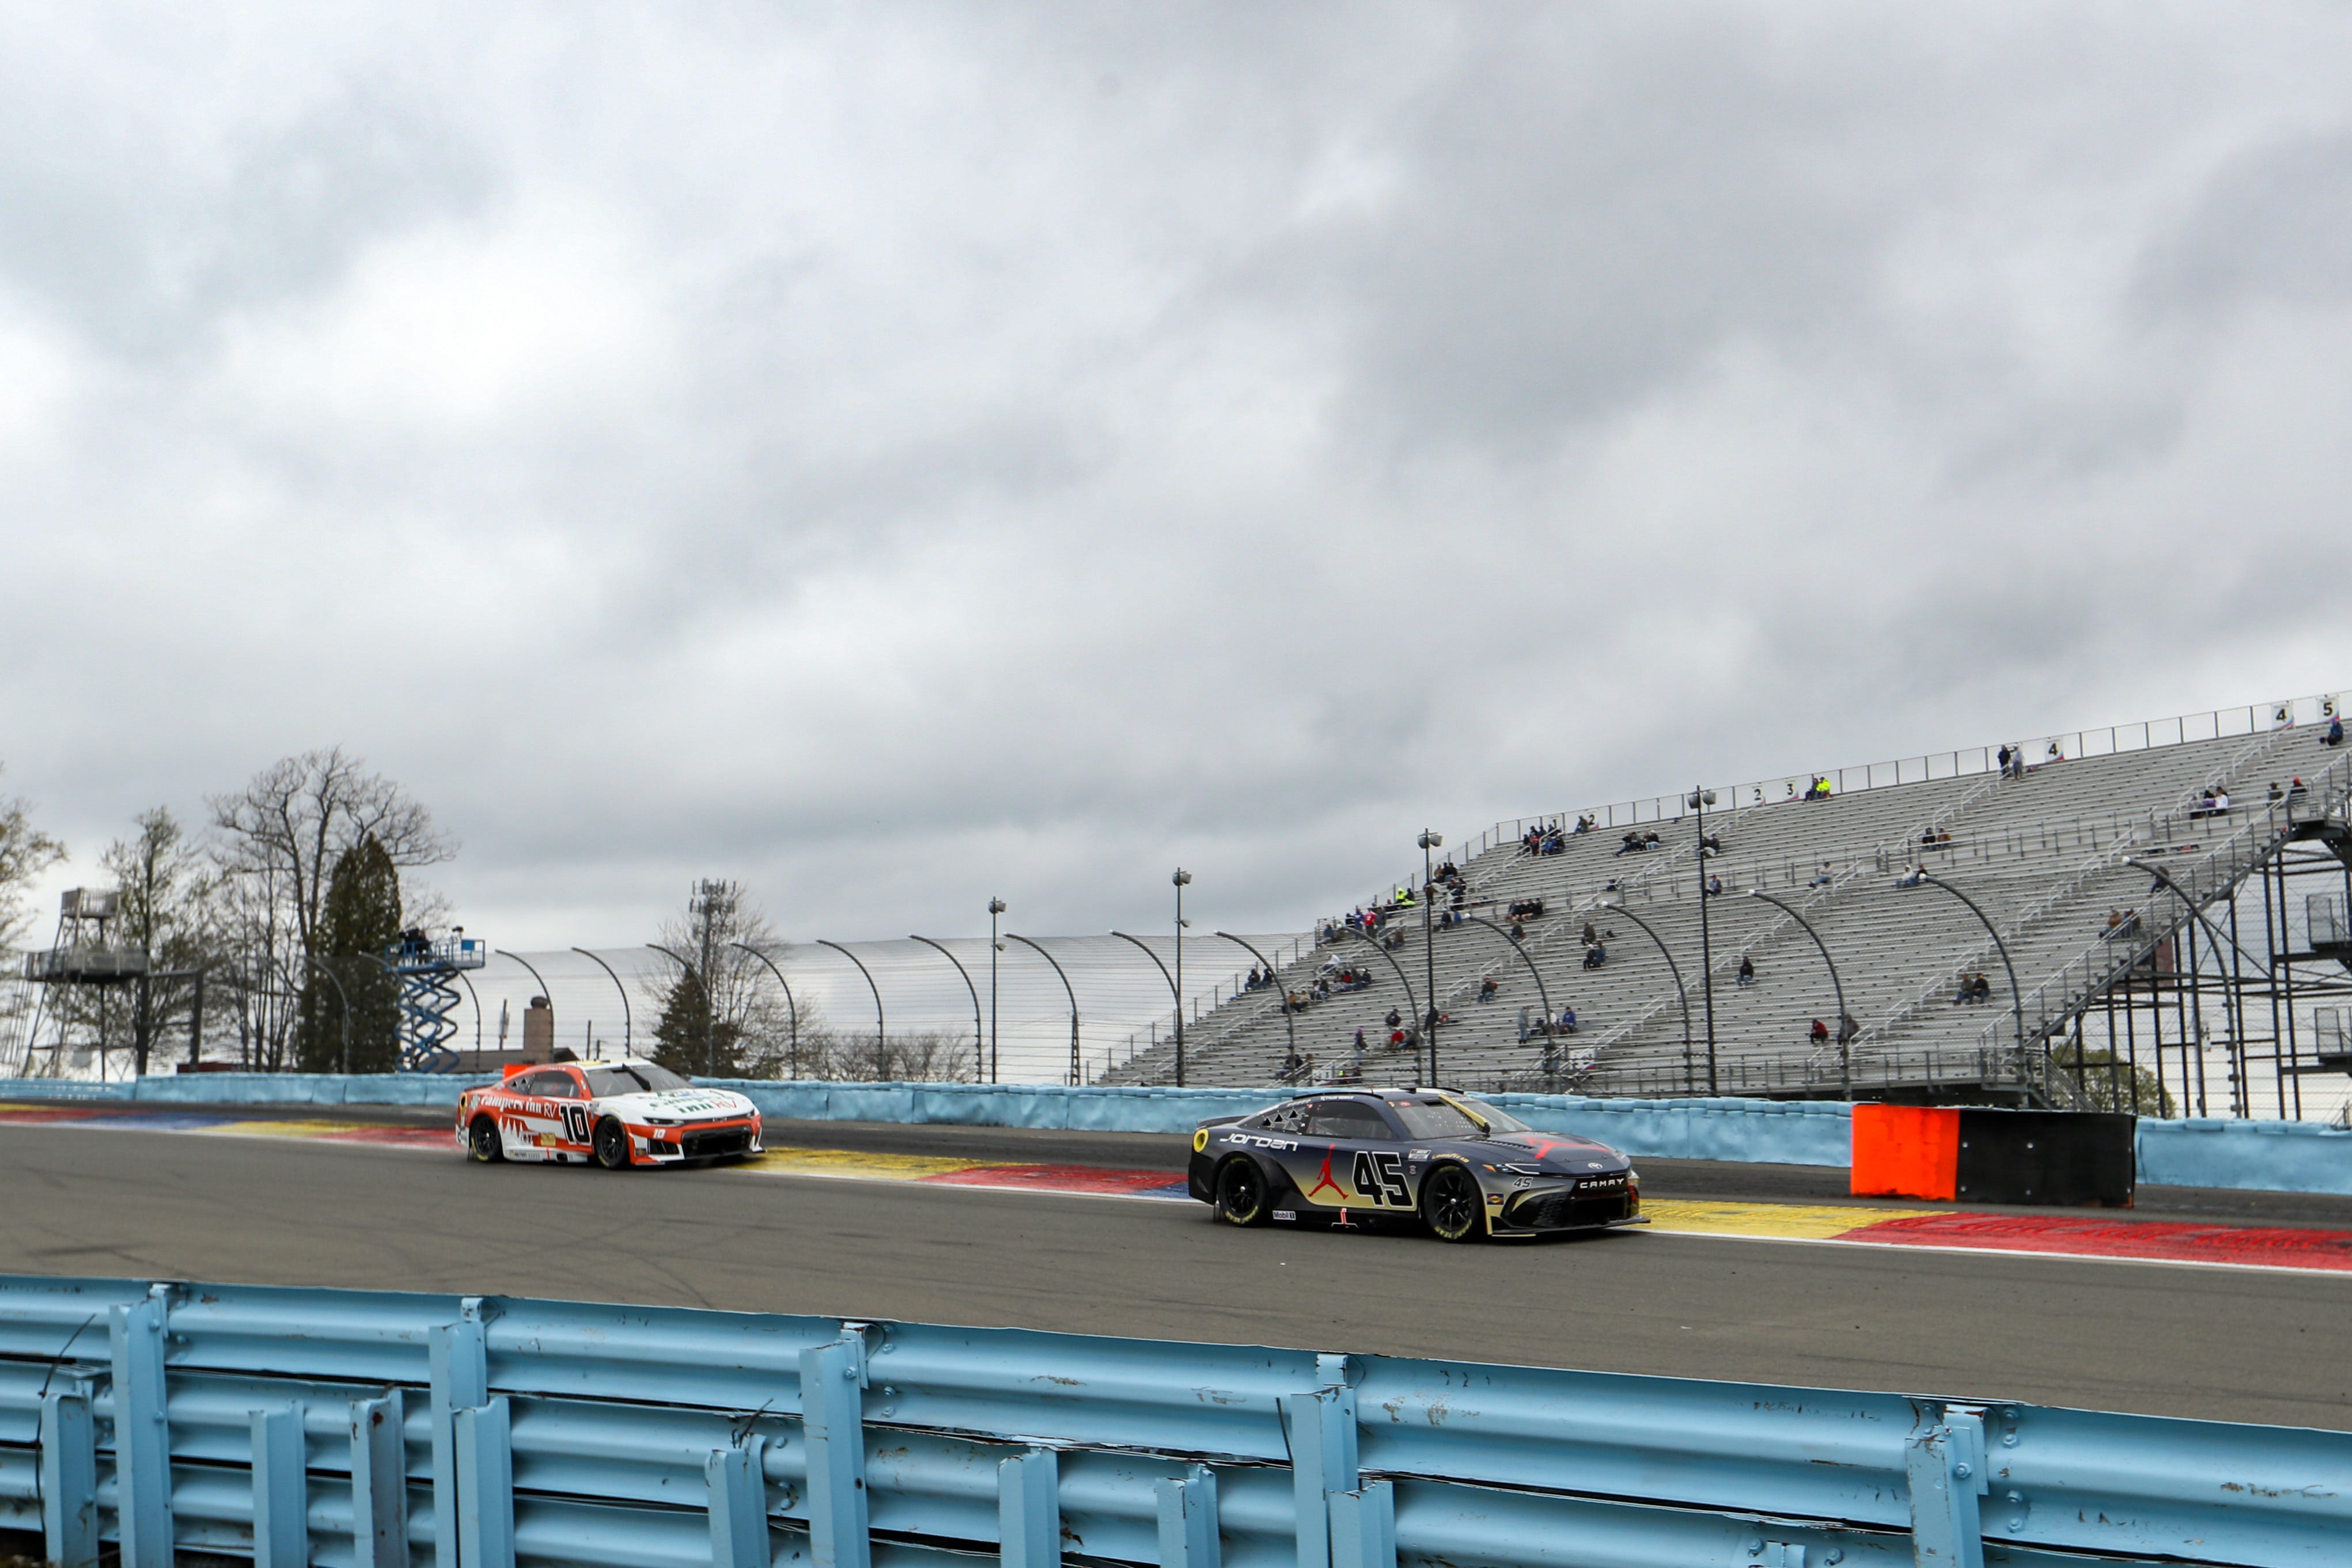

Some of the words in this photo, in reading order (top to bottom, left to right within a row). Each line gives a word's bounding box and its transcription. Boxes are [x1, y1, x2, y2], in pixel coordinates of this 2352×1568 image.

[2276, 708, 2286, 722] 4
[2323, 702, 2333, 716] 5
[2048, 743, 2058, 756] 4
[1754, 789, 1762, 801] 2
[1787, 783, 1793, 796] 3
[1588, 814, 1595, 825] 2
[525, 1097, 542, 1114] inn
[544, 1102, 558, 1119] RV
[559, 1103, 592, 1146] 10
[652, 1128, 666, 1139] 10
[1351, 1150, 1414, 1208] 45
[1513, 1177, 1534, 1188] 45
